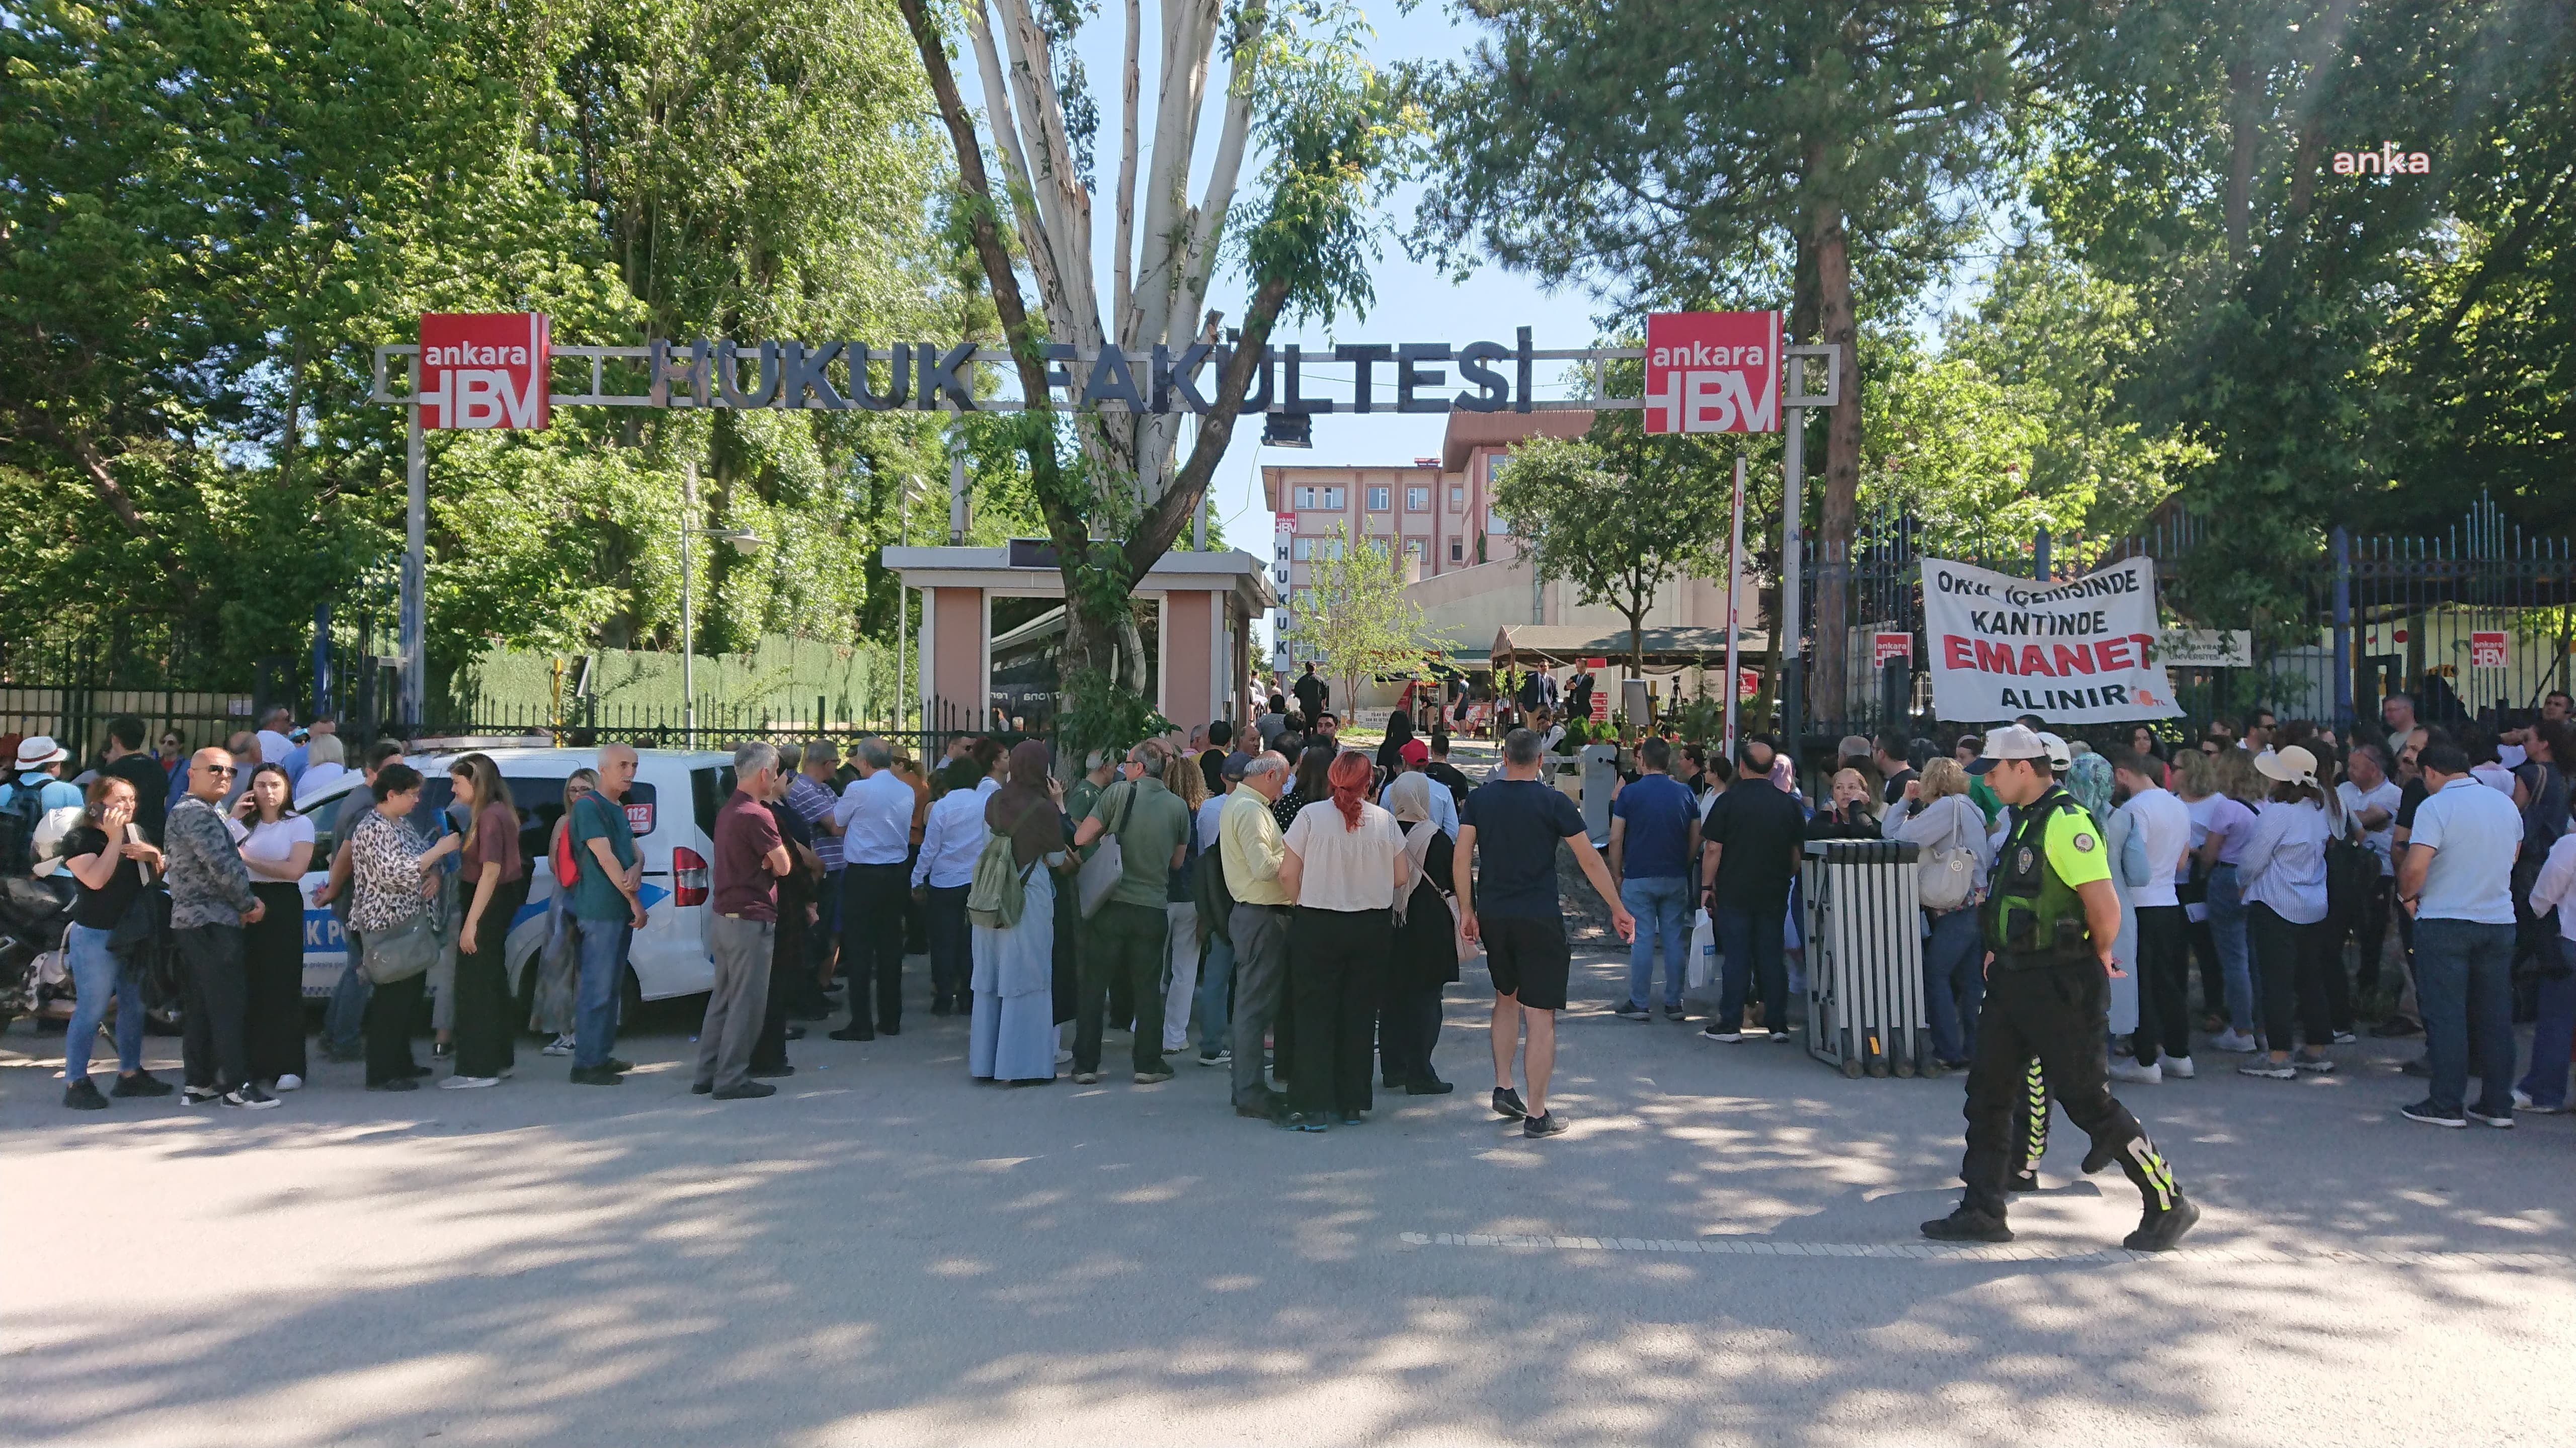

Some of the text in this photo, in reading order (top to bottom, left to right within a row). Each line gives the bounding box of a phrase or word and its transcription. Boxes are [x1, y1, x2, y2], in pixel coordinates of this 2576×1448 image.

[425, 342, 527, 366] ankara
[1653, 340, 1764, 367] ankara
[651, 325, 1533, 414] HUKUK FAKÜLTESİ
[1276, 547, 1289, 654] HUKUK
[1971, 611, 2108, 635] KANTİNDE
[1943, 633, 2155, 677] EMANET
[2001, 685, 2129, 710] ALINIR
[627, 807, 647, 821] 112
